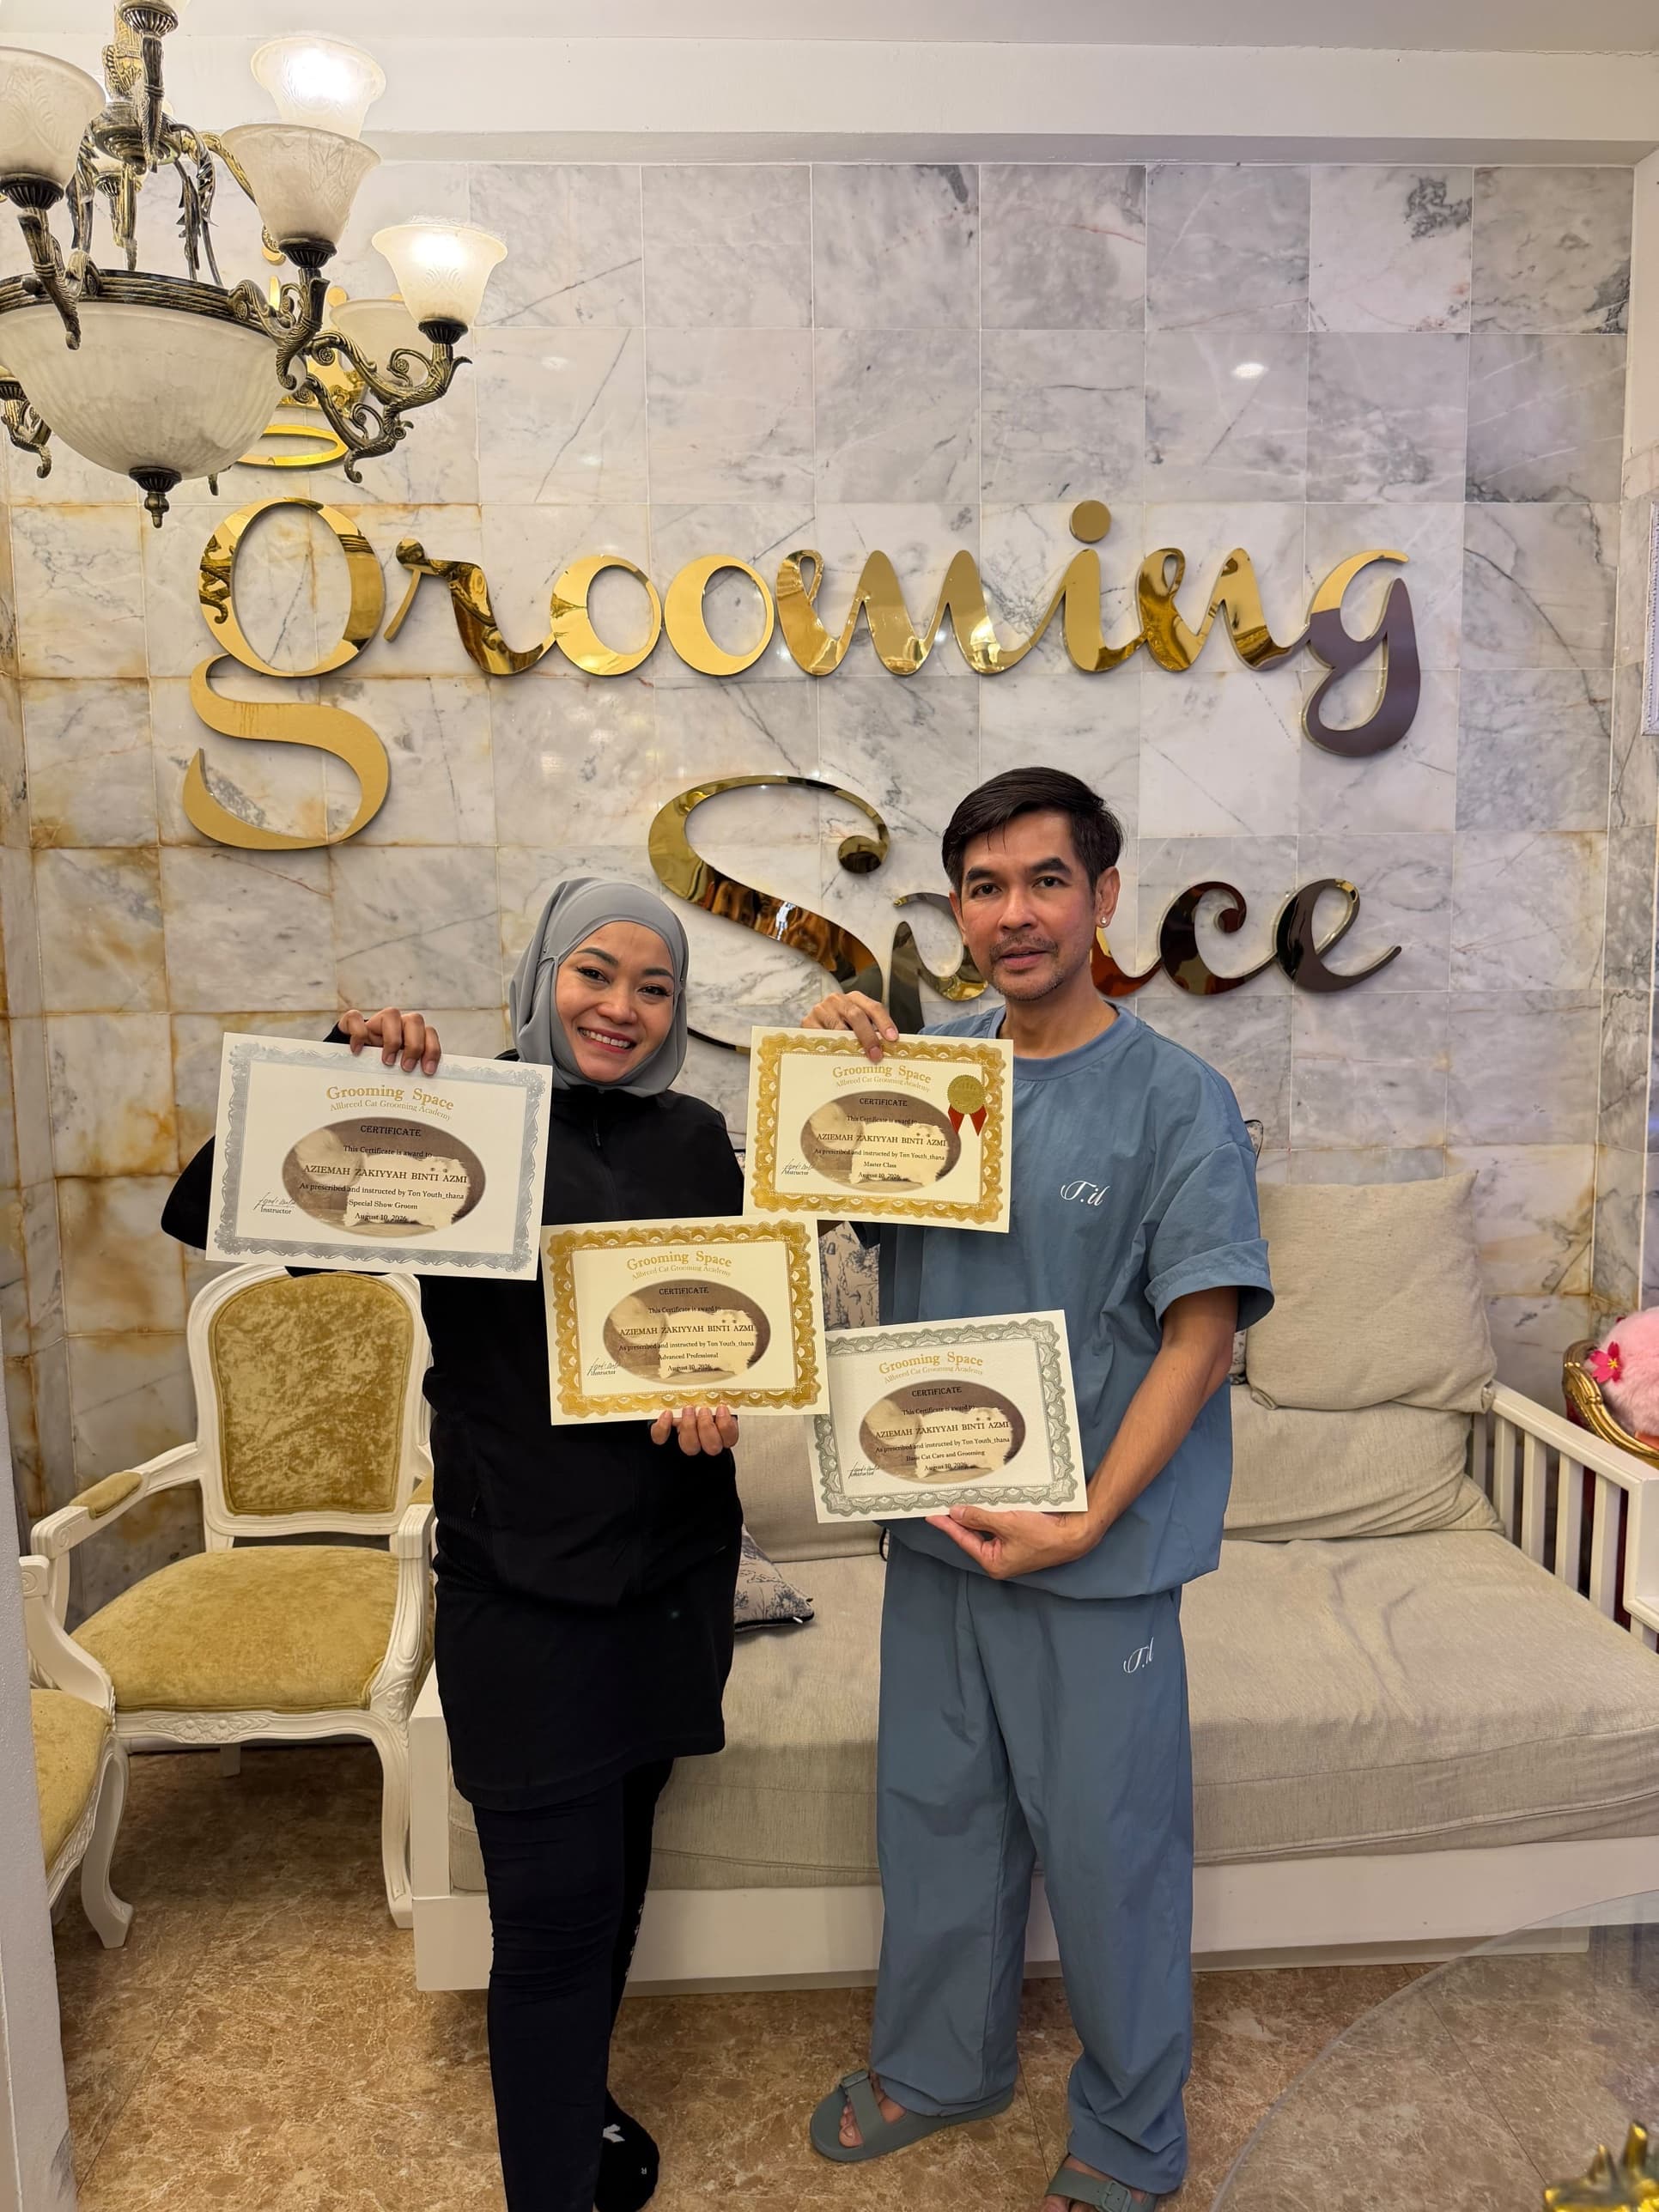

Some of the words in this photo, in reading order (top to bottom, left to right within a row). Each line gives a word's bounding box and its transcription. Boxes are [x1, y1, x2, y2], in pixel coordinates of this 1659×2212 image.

[833, 1065, 893, 1078] Grooming
[899, 1065, 932, 1083] Space
[326, 1085, 405, 1101] Grooming
[412, 1088, 454, 1110] Space
[859, 1098, 907, 1107] CERTIFICATE
[330, 1100, 362, 1112] Allbreed
[380, 1100, 418, 1112] Grooming
[419, 1106, 451, 1121] Academy
[360, 1125, 422, 1137] CERTIFICATE
[857, 1135, 898, 1143] ZAKIYYAH
[360, 1146, 396, 1155] Certificate
[403, 1150, 424, 1158] award
[303, 1165, 351, 1175] AZIEMAH
[356, 1168, 407, 1179] ZAKIYYAH
[412, 1173, 439, 1182] BINTI
[443, 1175, 468, 1183] AZMI
[362, 1187, 396, 1195] instructed
[398, 1188, 405, 1197] by
[349, 1199, 372, 1207] Special
[355, 1212, 379, 1221] August
[627, 1251, 689, 1270] Grooming
[696, 1250, 732, 1267] Space
[659, 1287, 709, 1295] CERTIFICATE
[620, 1328, 658, 1336] AZIEMAH
[661, 1325, 704, 1334] ZAKIYYAH
[879, 1354, 940, 1374] Grooming
[947, 1351, 983, 1366] Space
[912, 1387, 962, 1397] CERTIFICATE
[876, 1429, 912, 1438] AZIEMAH
[915, 1425, 958, 1434] ZAKIYYAH
